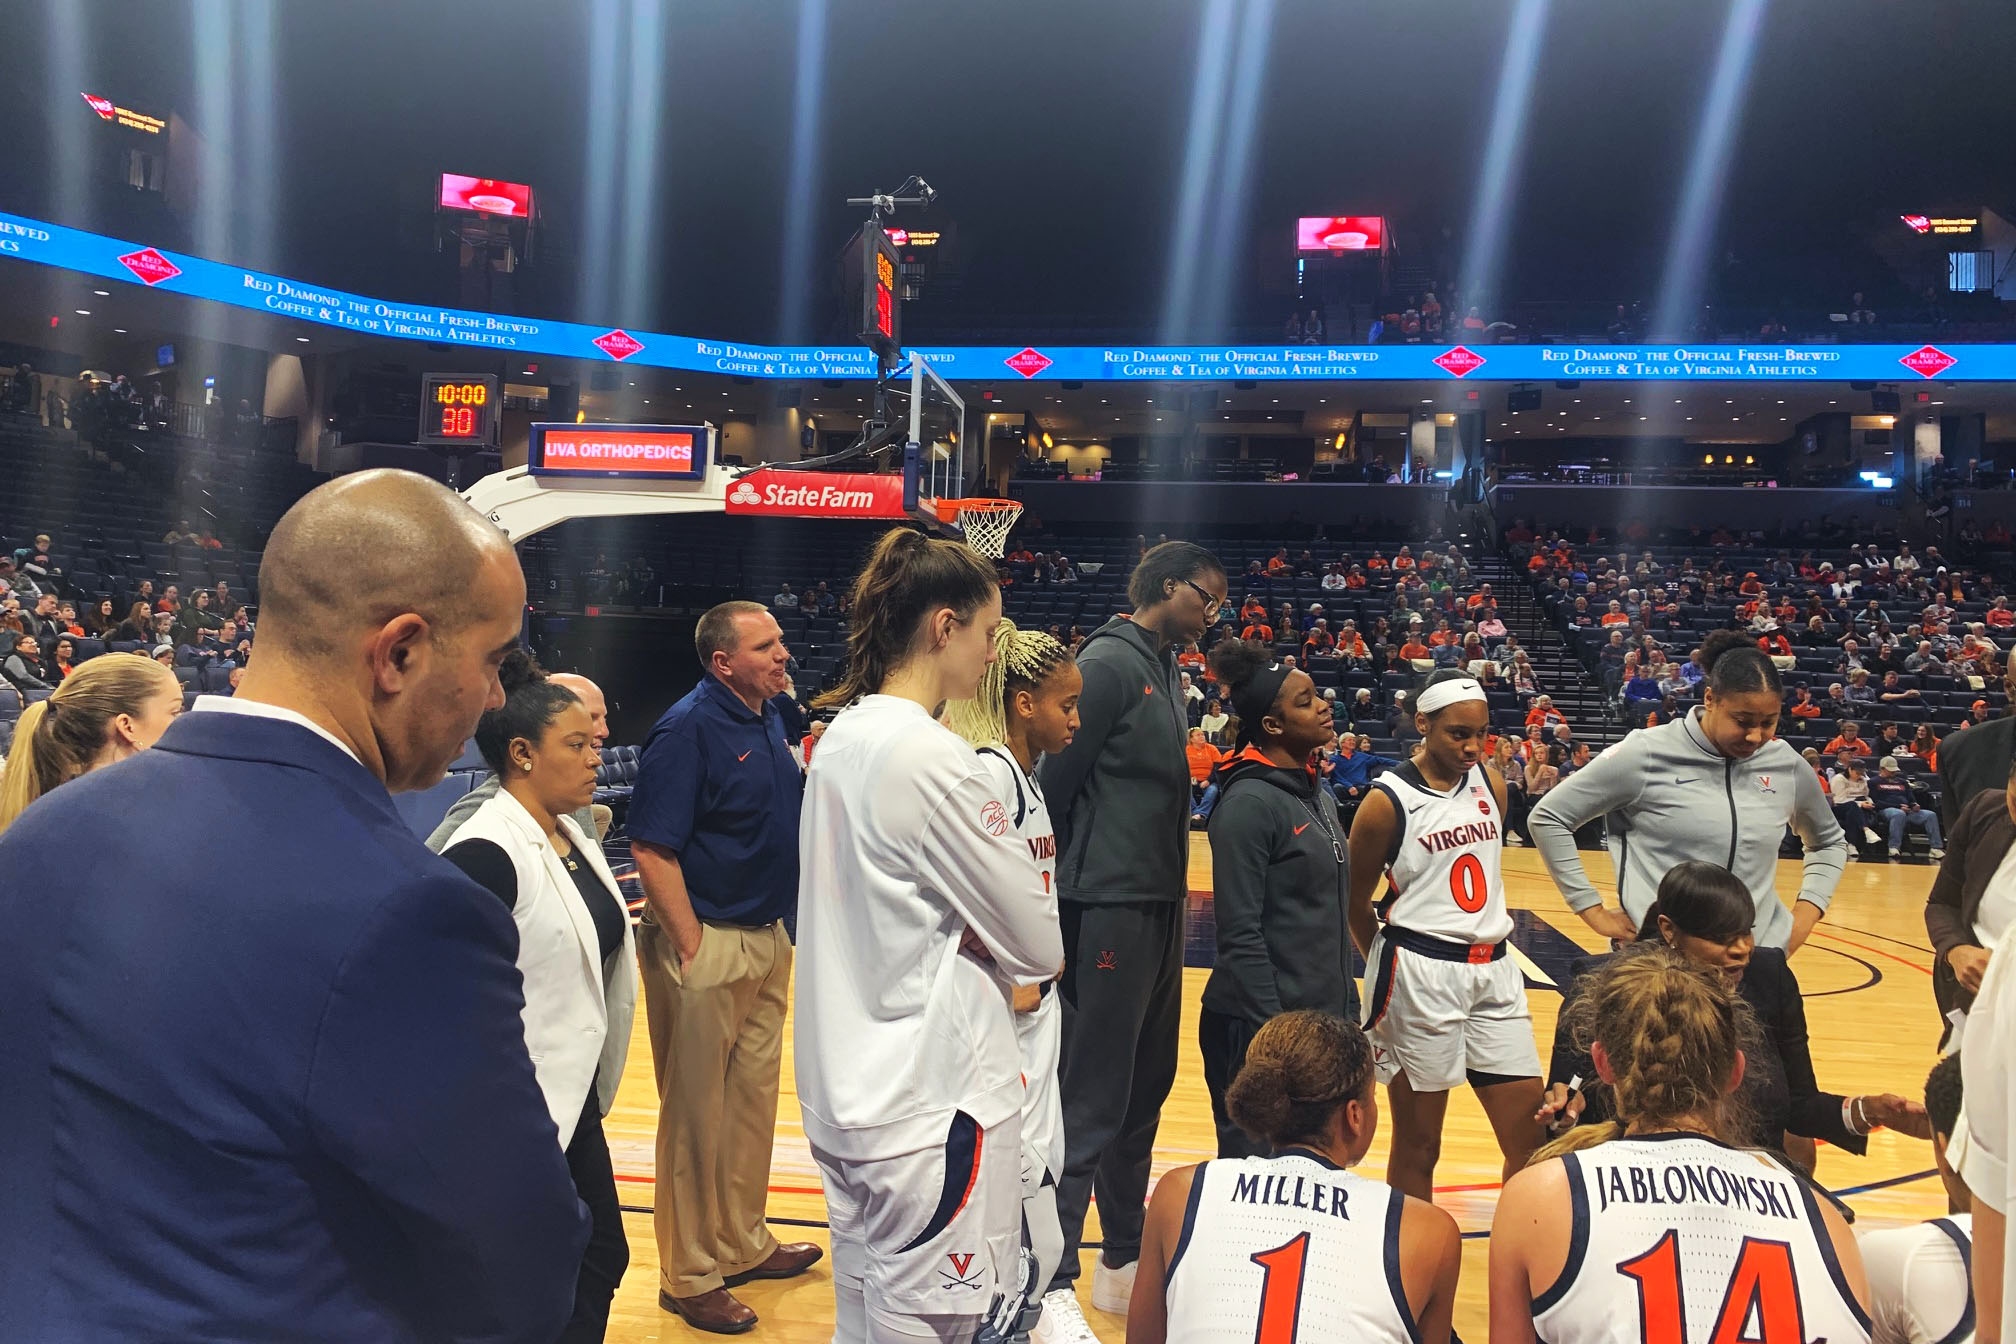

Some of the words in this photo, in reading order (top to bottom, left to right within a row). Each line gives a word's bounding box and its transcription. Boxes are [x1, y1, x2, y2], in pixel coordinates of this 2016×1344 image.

[126, 257, 176, 275] DIAMOND
[141, 254, 162, 265] RED
[319, 308, 332, 320] &
[600, 340, 640, 350] DIAMOND
[612, 335, 628, 343] RED
[697, 342, 722, 356] RED
[726, 346, 782, 361] DIAMOND
[814, 350, 864, 362] OFFICIAL
[764, 363, 775, 374] &
[1172, 364, 1183, 375] &
[1617, 363, 1630, 374] &
[437, 384, 486, 405] 10:00
[442, 408, 473, 435] 30
[545, 443, 577, 458] UVA
[580, 443, 692, 459] ORTHOPEDICS
[550, 580, 556, 589] 3
[986, 806, 1004, 826] ACC
[1418, 821, 1499, 855] VIRGINIA
[1450, 853, 1488, 913] 0
[1230, 1173, 1351, 1221] MILLER
[1595, 1164, 1799, 1220] JABLONOWSKI
[1250, 1231, 1311, 1344] 1
[1616, 1229, 1828, 1344] 14
